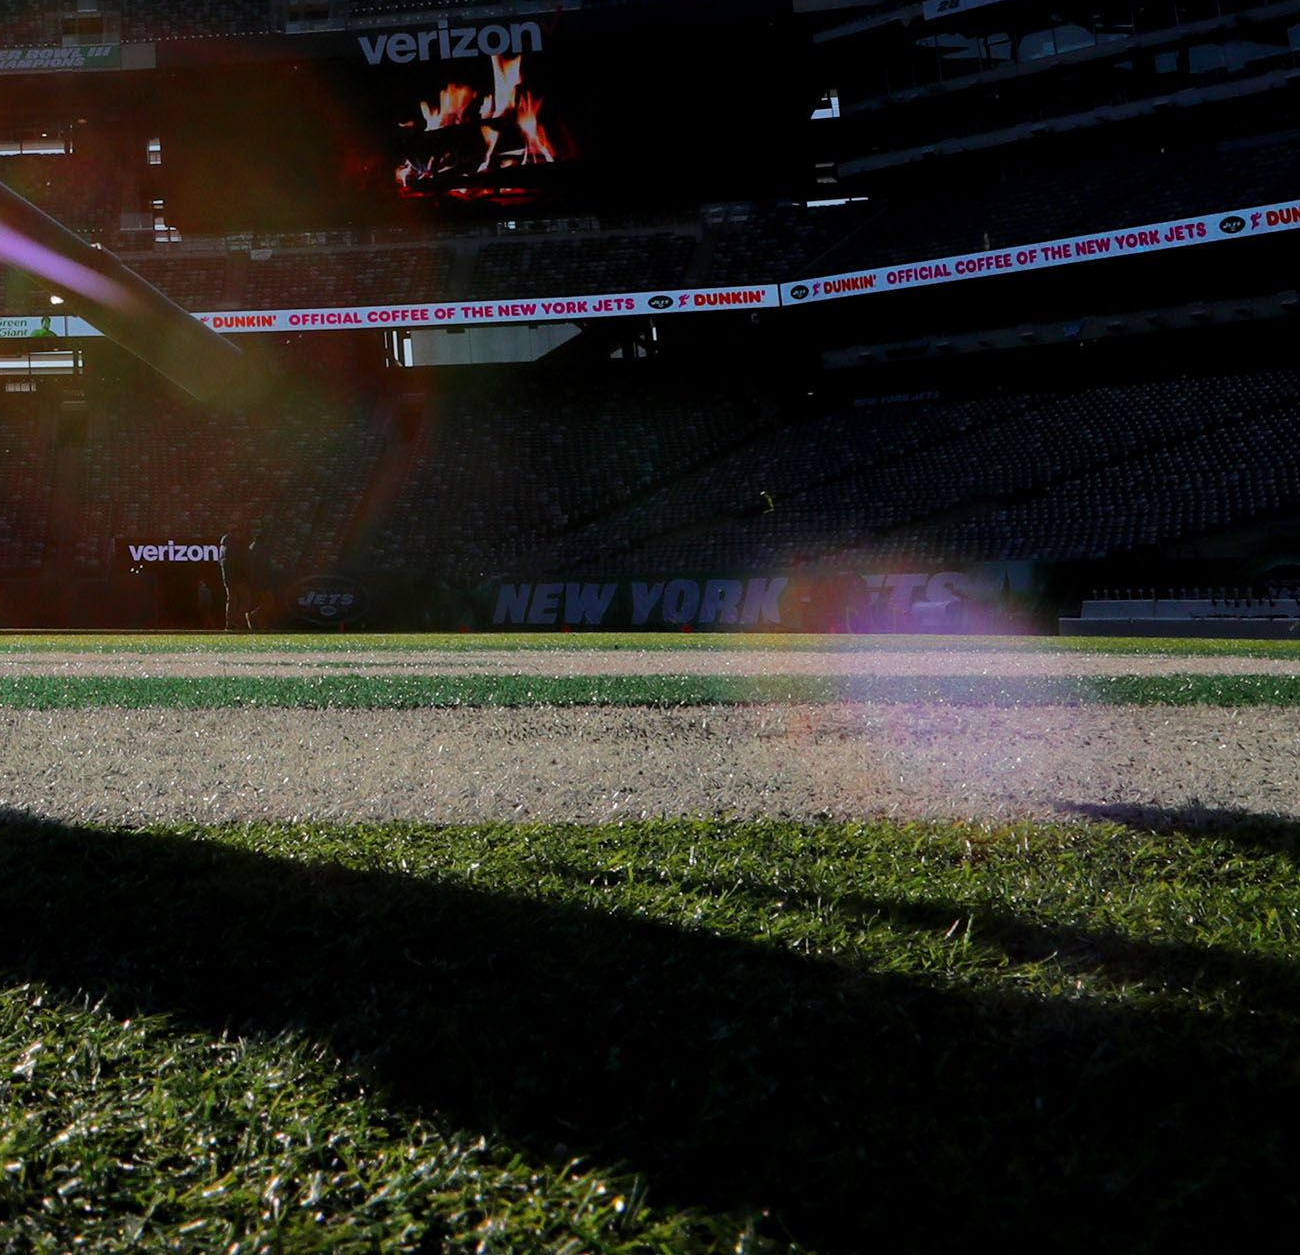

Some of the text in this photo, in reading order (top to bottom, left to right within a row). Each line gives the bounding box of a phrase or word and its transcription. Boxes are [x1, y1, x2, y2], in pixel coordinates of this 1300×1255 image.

[357, 19, 544, 65] verizon
[25, 47, 81, 60] BOWL
[87, 46, 113, 58] III
[887, 223, 1207, 284] OFFICIAL COFFEE OF THE NEW YORK JETS
[823, 274, 876, 294] DUNKIN'
[694, 290, 766, 306] DUNKIN'
[212, 315, 277, 328] DUNKIN'
[289, 298, 635, 326] OFFICIAL COFFEE OF THE NEW YORK JETS
[128, 540, 219, 561] verizon
[298, 591, 354, 606] JETS
[493, 583, 617, 625] NEW
[630, 577, 788, 624] YORK
